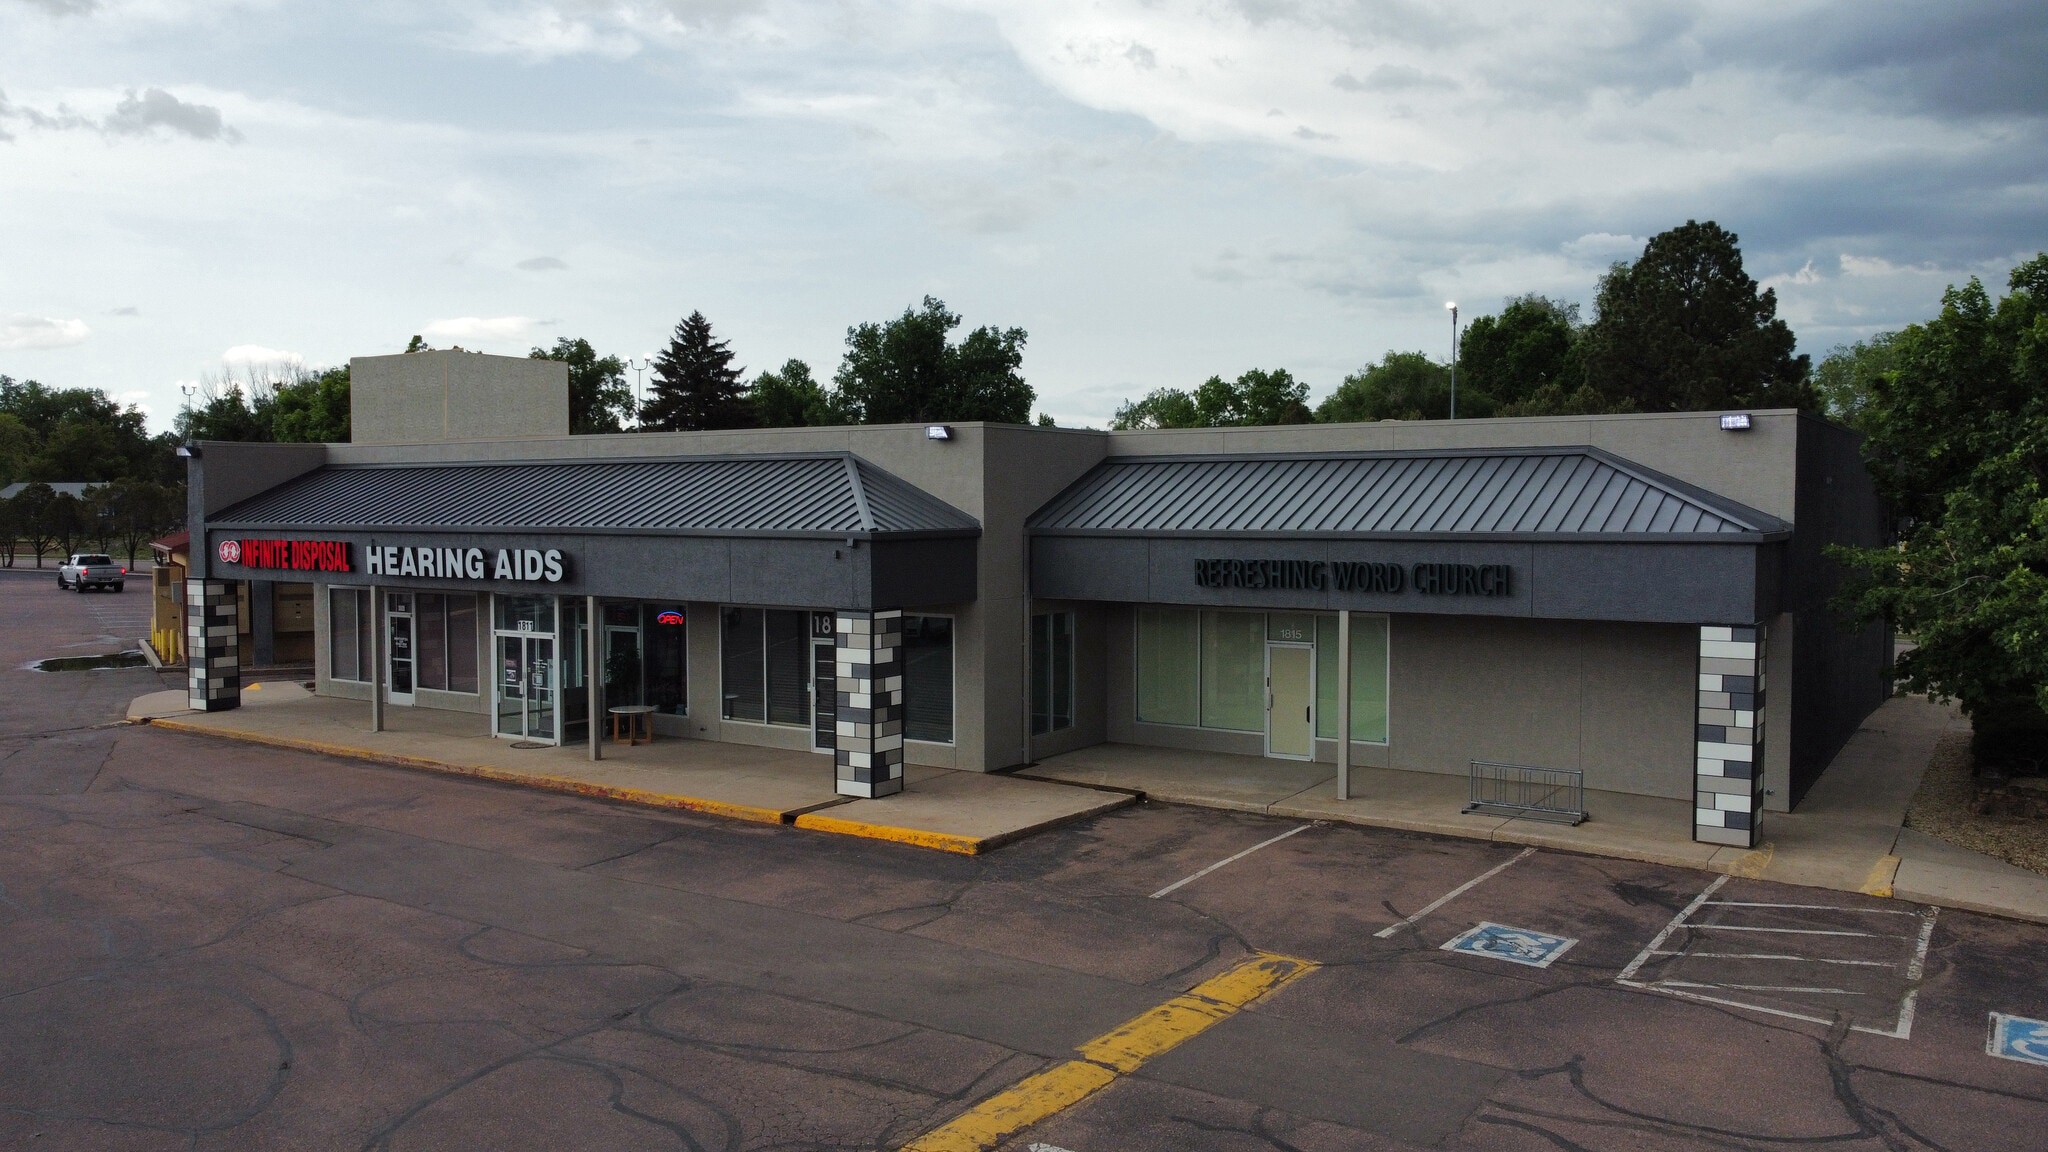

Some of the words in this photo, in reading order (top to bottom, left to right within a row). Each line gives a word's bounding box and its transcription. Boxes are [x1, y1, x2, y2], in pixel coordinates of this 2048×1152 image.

[241, 539, 288, 570] INFINITE
[292, 541, 349, 572] DISPOSAL
[366, 545, 485, 579] HEARING
[494, 549, 563, 582] AIDS
[1195, 559, 1328, 591] REFRESHING
[1331, 561, 1401, 593] WORD
[1410, 563, 1512, 596] CHURCH
[657, 614, 684, 625] OPEN
[1280, 629, 1302, 639] 1815
